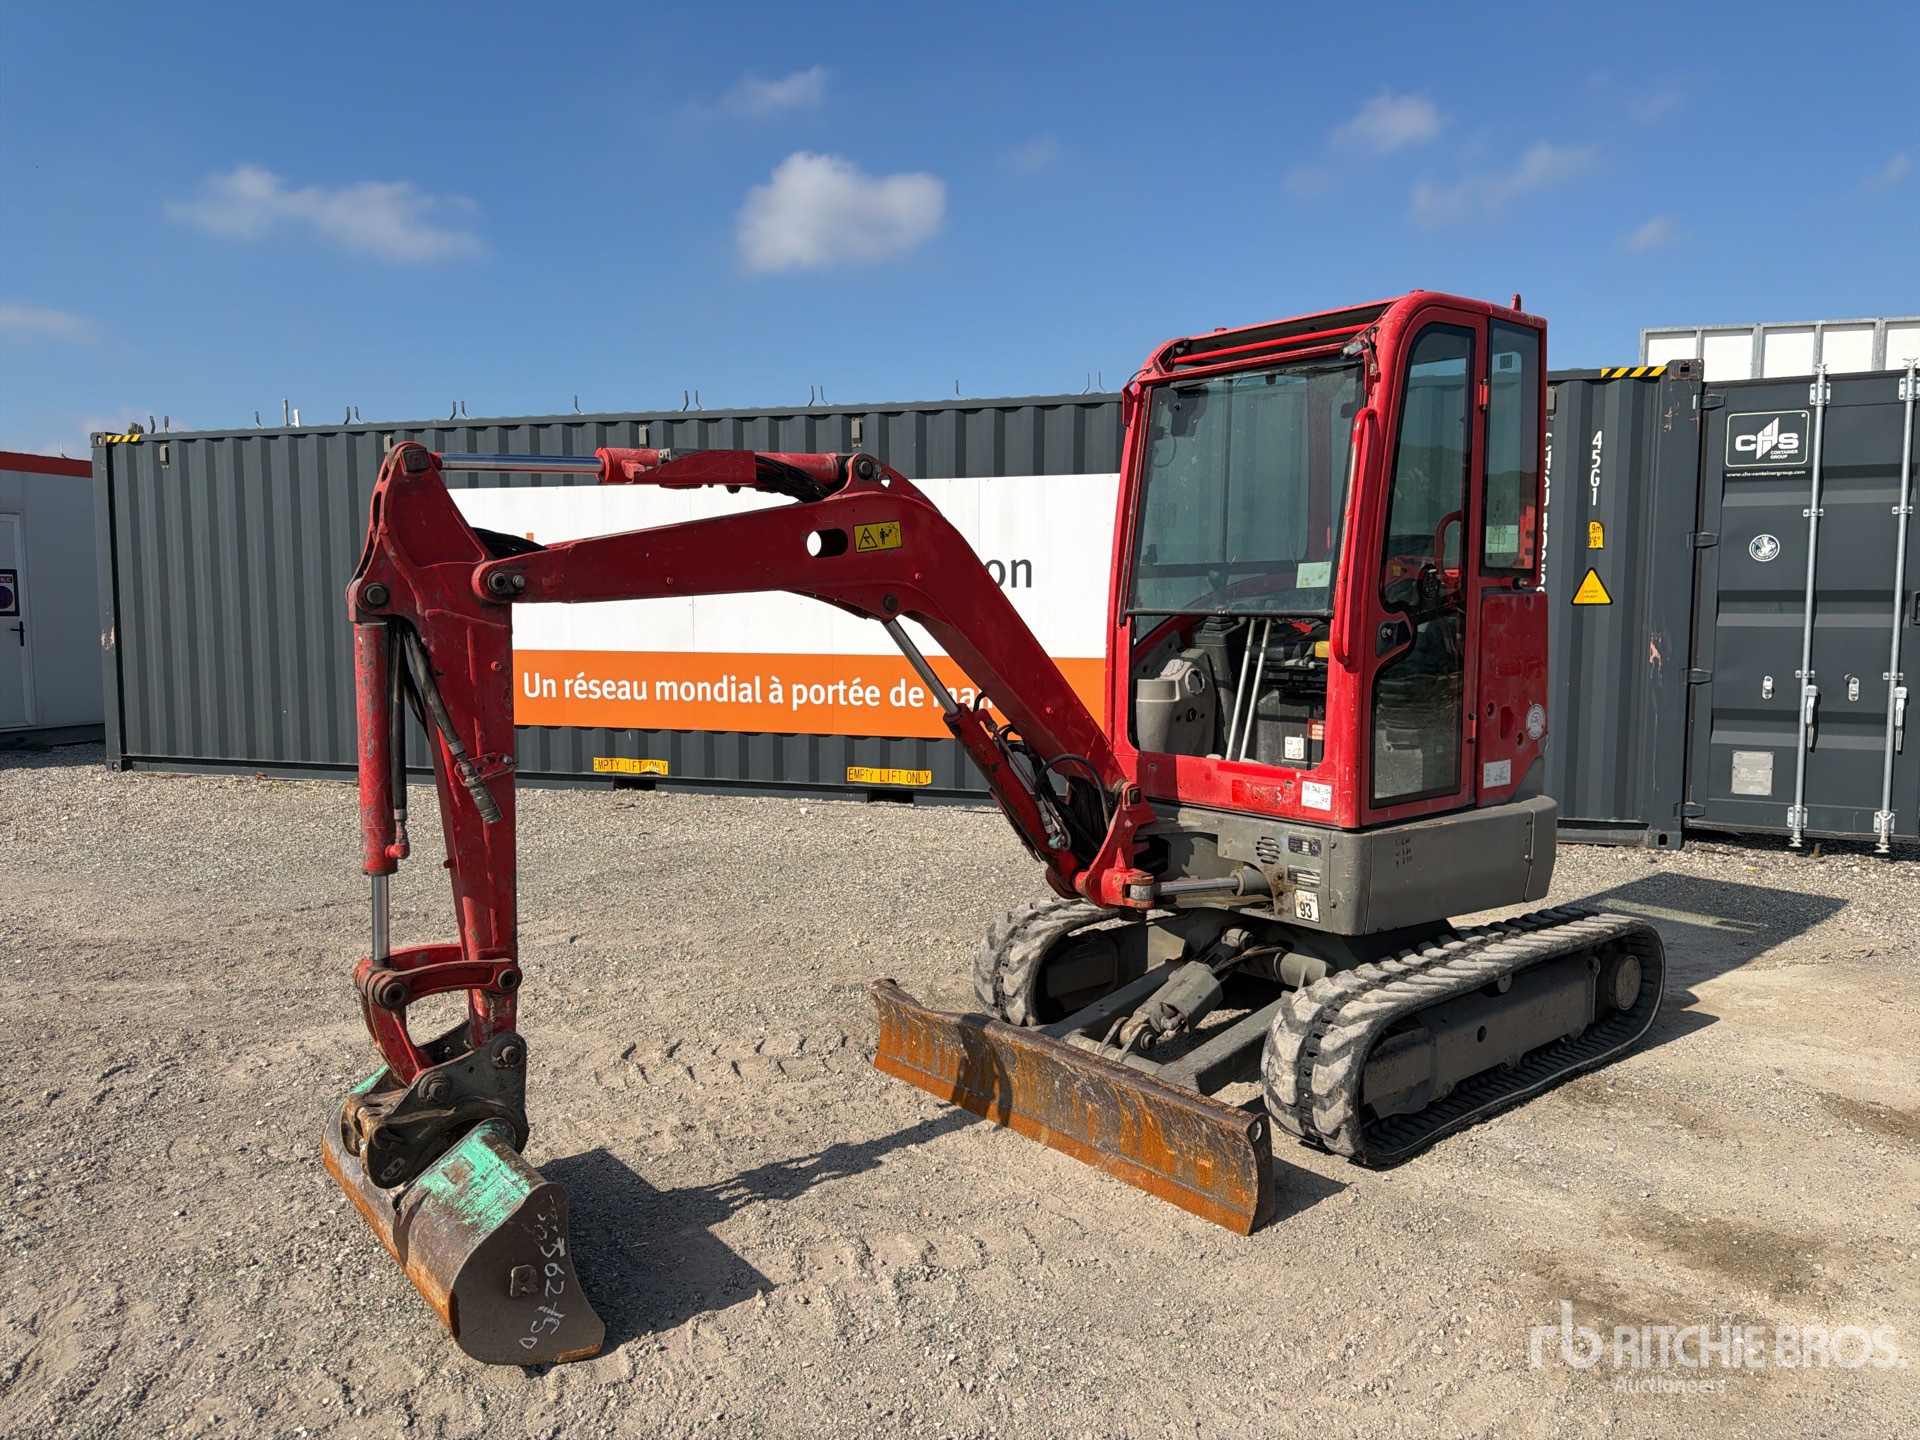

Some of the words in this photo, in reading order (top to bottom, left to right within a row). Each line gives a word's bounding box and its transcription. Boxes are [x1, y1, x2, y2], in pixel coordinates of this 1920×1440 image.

[1735, 417, 1799, 460] CHS
[523, 672, 557, 698] Un
[564, 671, 648, 700] réseau
[655, 674, 763, 703] mondial
[768, 675, 784, 704] à
[791, 677, 881, 711] portée
[889, 678, 925, 707] de
[594, 759, 620, 771] EMPTY
[624, 760, 643, 772] LIFT
[848, 768, 874, 781] EMPTY
[879, 769, 902, 782] LIFT
[906, 771, 930, 784] ONLY
[1299, 901, 1313, 919] 93
